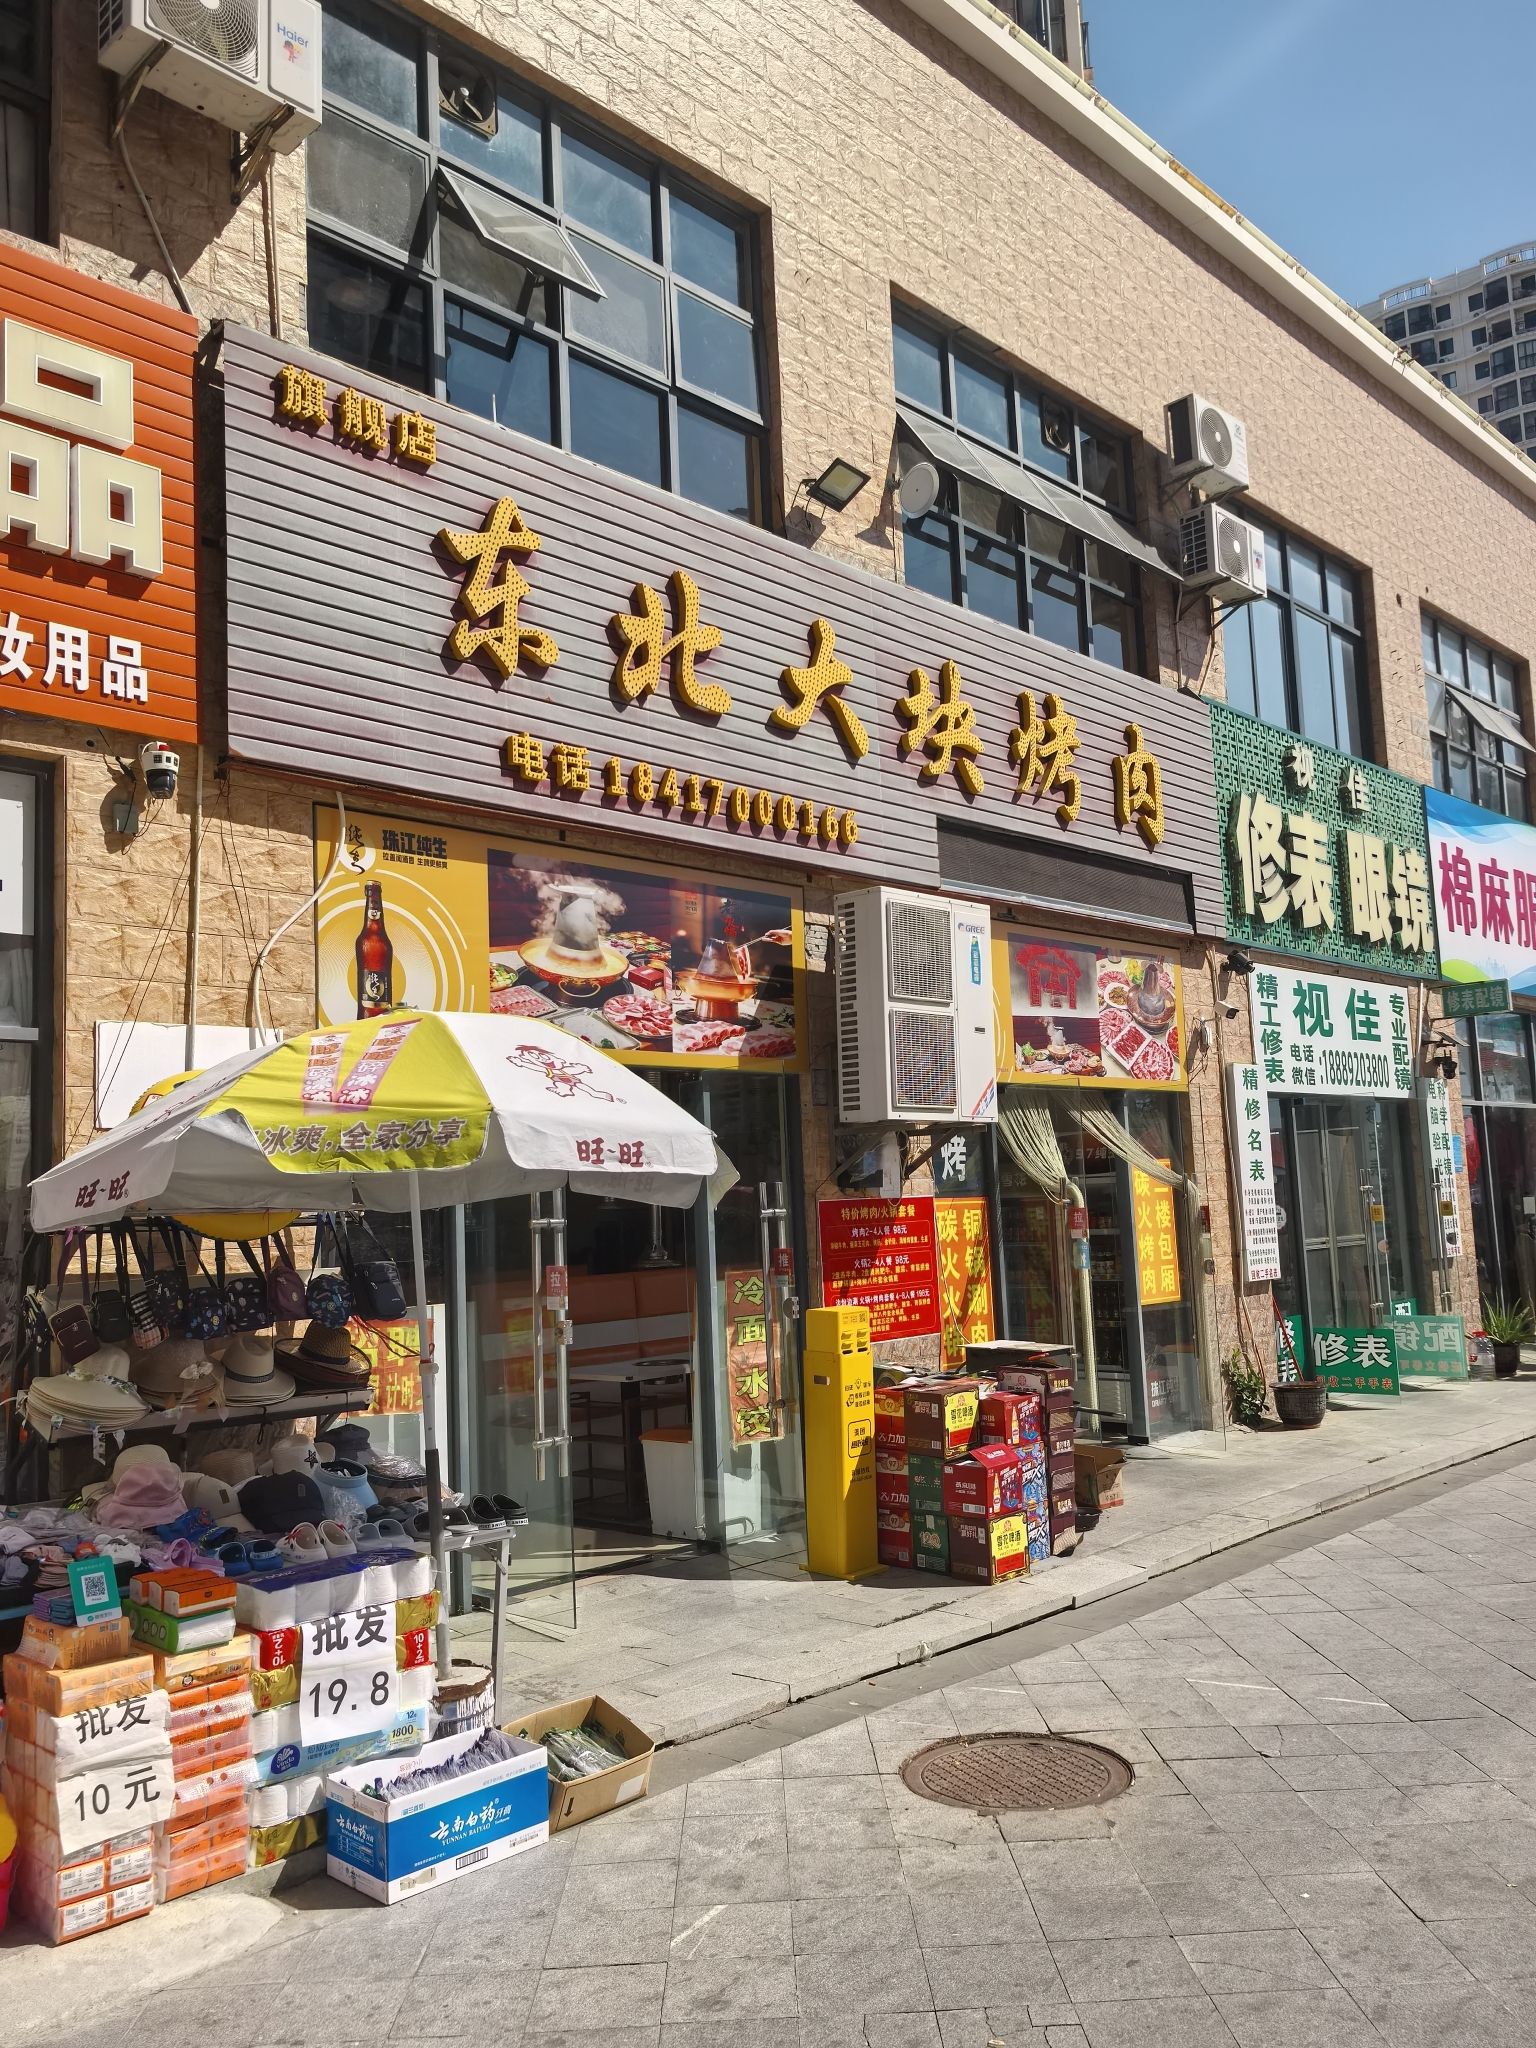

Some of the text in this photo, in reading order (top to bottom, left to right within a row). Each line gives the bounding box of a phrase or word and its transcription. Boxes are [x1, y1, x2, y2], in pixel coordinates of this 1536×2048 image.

[276, 22, 309, 48] Haier
[276, 364, 438, 467] 旗舰店
[437, 496, 1164, 846] 东北大块烤肉
[382, 829, 448, 860] 珠江纯生
[1235, 790, 1434, 953] 修表眼镜
[965, 925, 985, 934] GREE
[1256, 972, 1286, 1084] 精工修表
[1292, 979, 1382, 1042] 视佳
[1290, 1043, 1314, 1062] 电话
[1388, 993, 1412, 1091] 专业配镜
[1291, 1066, 1316, 1086] 微信
[255, 1117, 466, 1157] 冰爽，全家分享
[1242, 1067, 1266, 1183] 精修名表
[941, 1134, 967, 1182] 烤
[1133, 1170, 1157, 1295] 碳火烤肉
[550, 1271, 562, 1287] 拉
[733, 1276, 772, 1437] 冷面水饺
[1313, 1332, 1393, 1370] 修表
[312, 1605, 388, 1655] 批发
[308, 1671, 390, 1718] 19.8
[73, 1696, 151, 1745] 批发
[391, 1724, 414, 1739] 1800
[75, 1766, 161, 1822] 10元
[441, 1823, 491, 1847] YUNNAN BAIYAO
